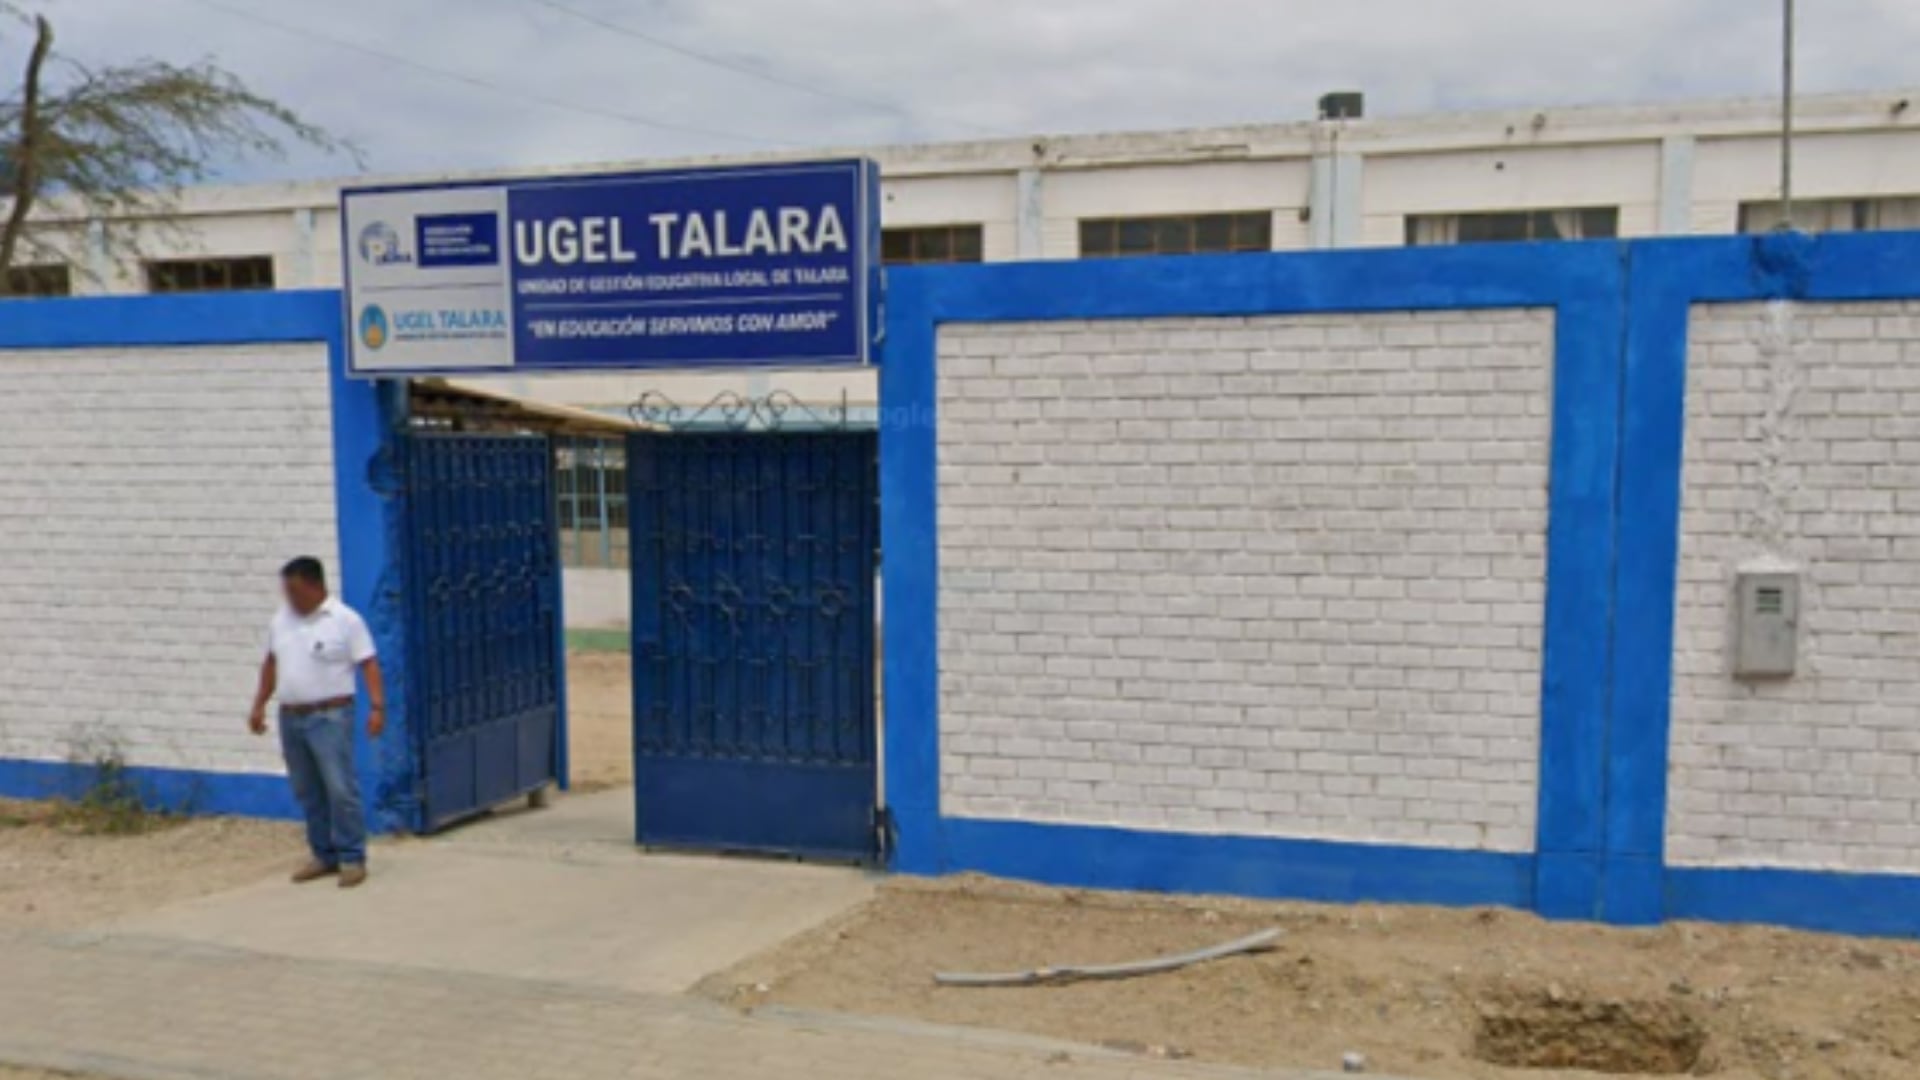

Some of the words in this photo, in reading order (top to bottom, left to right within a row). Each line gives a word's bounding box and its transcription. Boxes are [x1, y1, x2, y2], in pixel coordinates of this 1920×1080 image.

[515, 216, 637, 266] UGEL
[649, 203, 849, 260] TALARA
[517, 278, 567, 294] UNIDAD
[569, 277, 586, 293] DE
[589, 272, 644, 293] GESTIÓN
[645, 270, 722, 291] EDUCATIVA
[724, 270, 768, 288] LOCAL
[771, 268, 790, 285] DE
[794, 266, 848, 284] TALARA
[394, 310, 434, 330] UGEL
[438, 308, 507, 329] TALARA
[558, 314, 646, 338] EDUCACIÓN
[649, 315, 733, 336] SERVIMOS
[737, 313, 774, 332] CON
